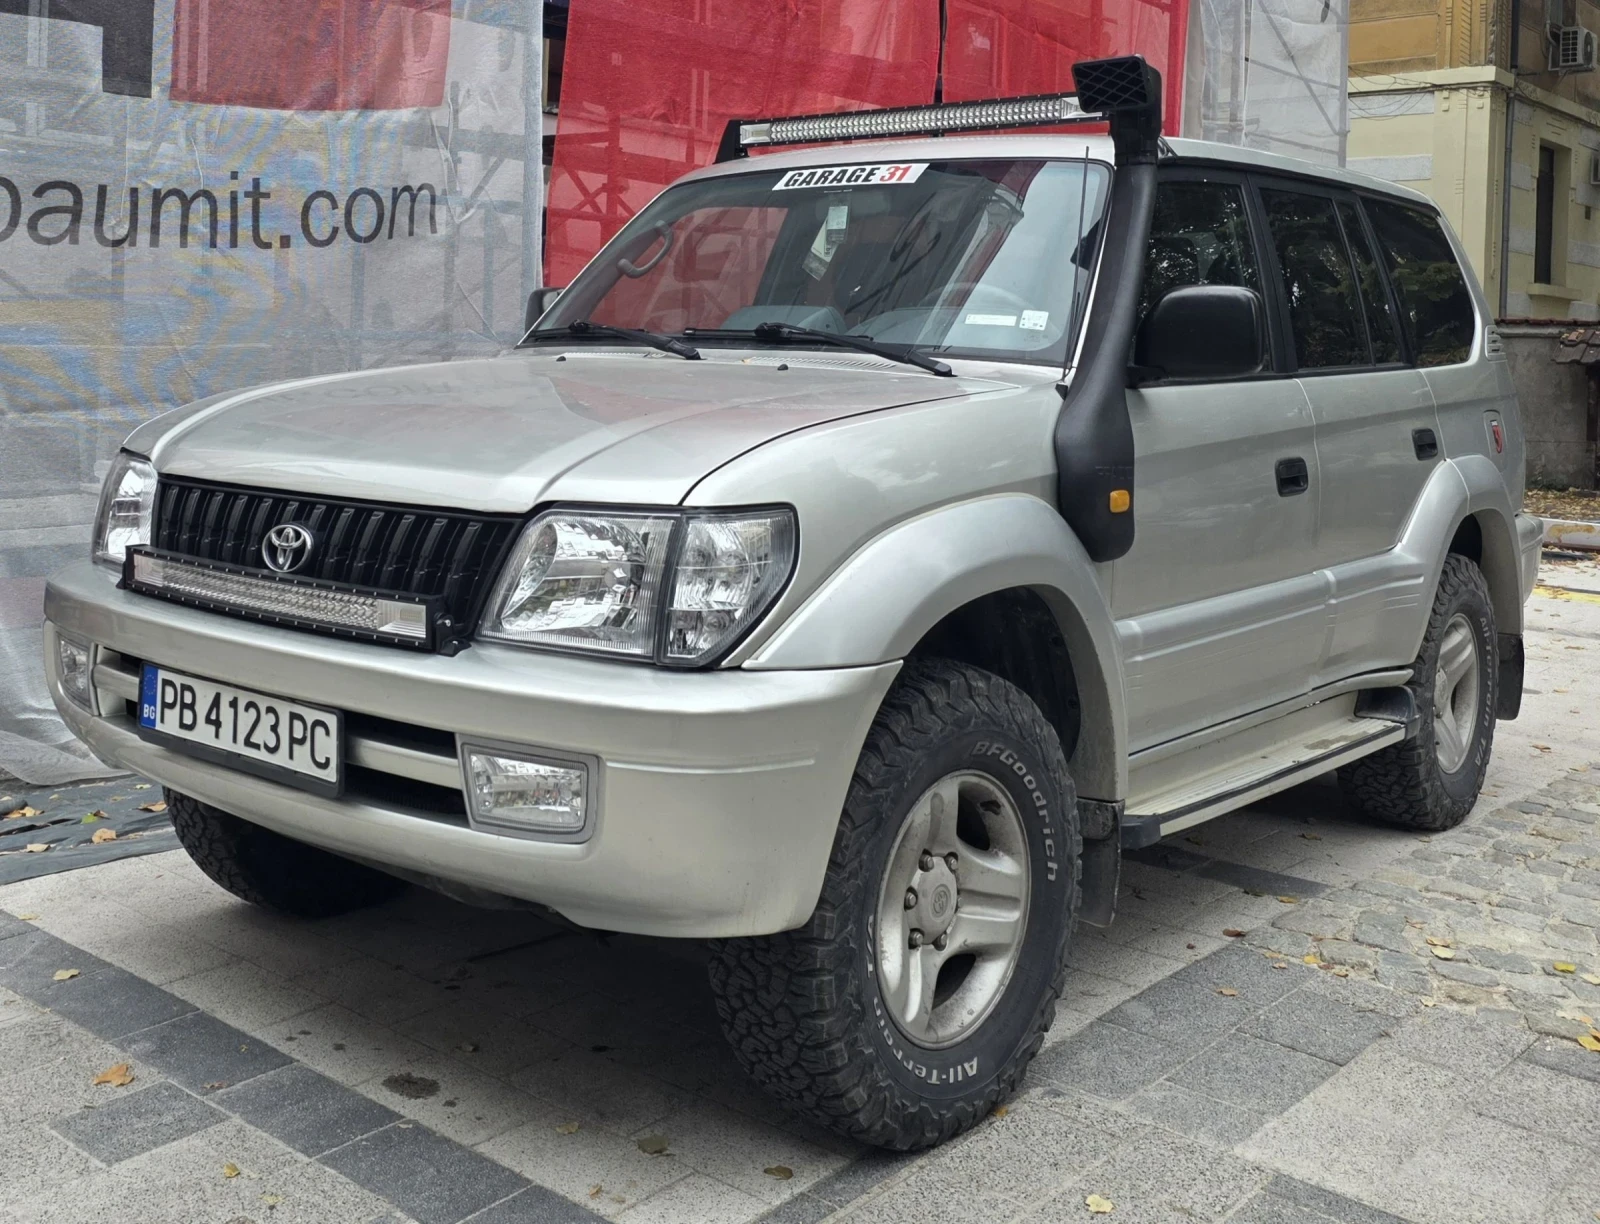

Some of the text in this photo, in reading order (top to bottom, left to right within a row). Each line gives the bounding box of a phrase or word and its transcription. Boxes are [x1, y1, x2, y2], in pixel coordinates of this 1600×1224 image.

[784, 165, 912, 187] GARAGE 31
[143, 703, 156, 720] BG
[160, 677, 331, 770] PB 4123 PC
[1474, 616, 1494, 767] All-Terrain T/A
[971, 740, 1058, 882] BFGoodrich
[873, 996, 978, 1085] All-Terrain
